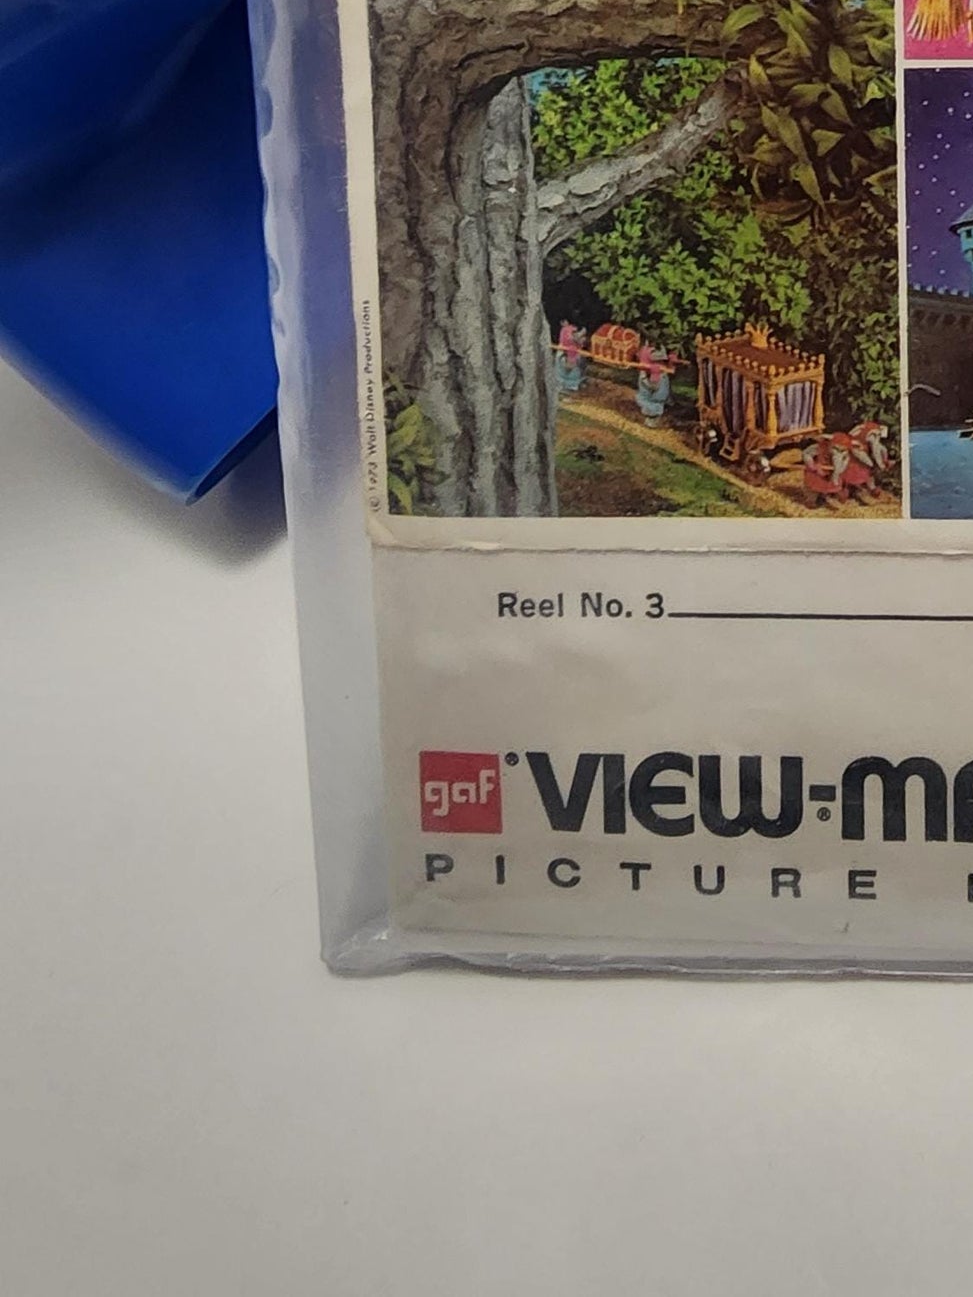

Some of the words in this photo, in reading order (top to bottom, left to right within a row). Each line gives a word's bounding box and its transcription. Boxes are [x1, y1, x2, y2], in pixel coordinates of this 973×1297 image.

[361, 299, 374, 377] Productions
[363, 378, 376, 421] Disney
[364, 423, 378, 457] Walt
[497, 592, 564, 618] Reel
[580, 592, 633, 618] No.
[424, 768, 497, 817] gaf
[424, 852, 878, 901] PICTURE
